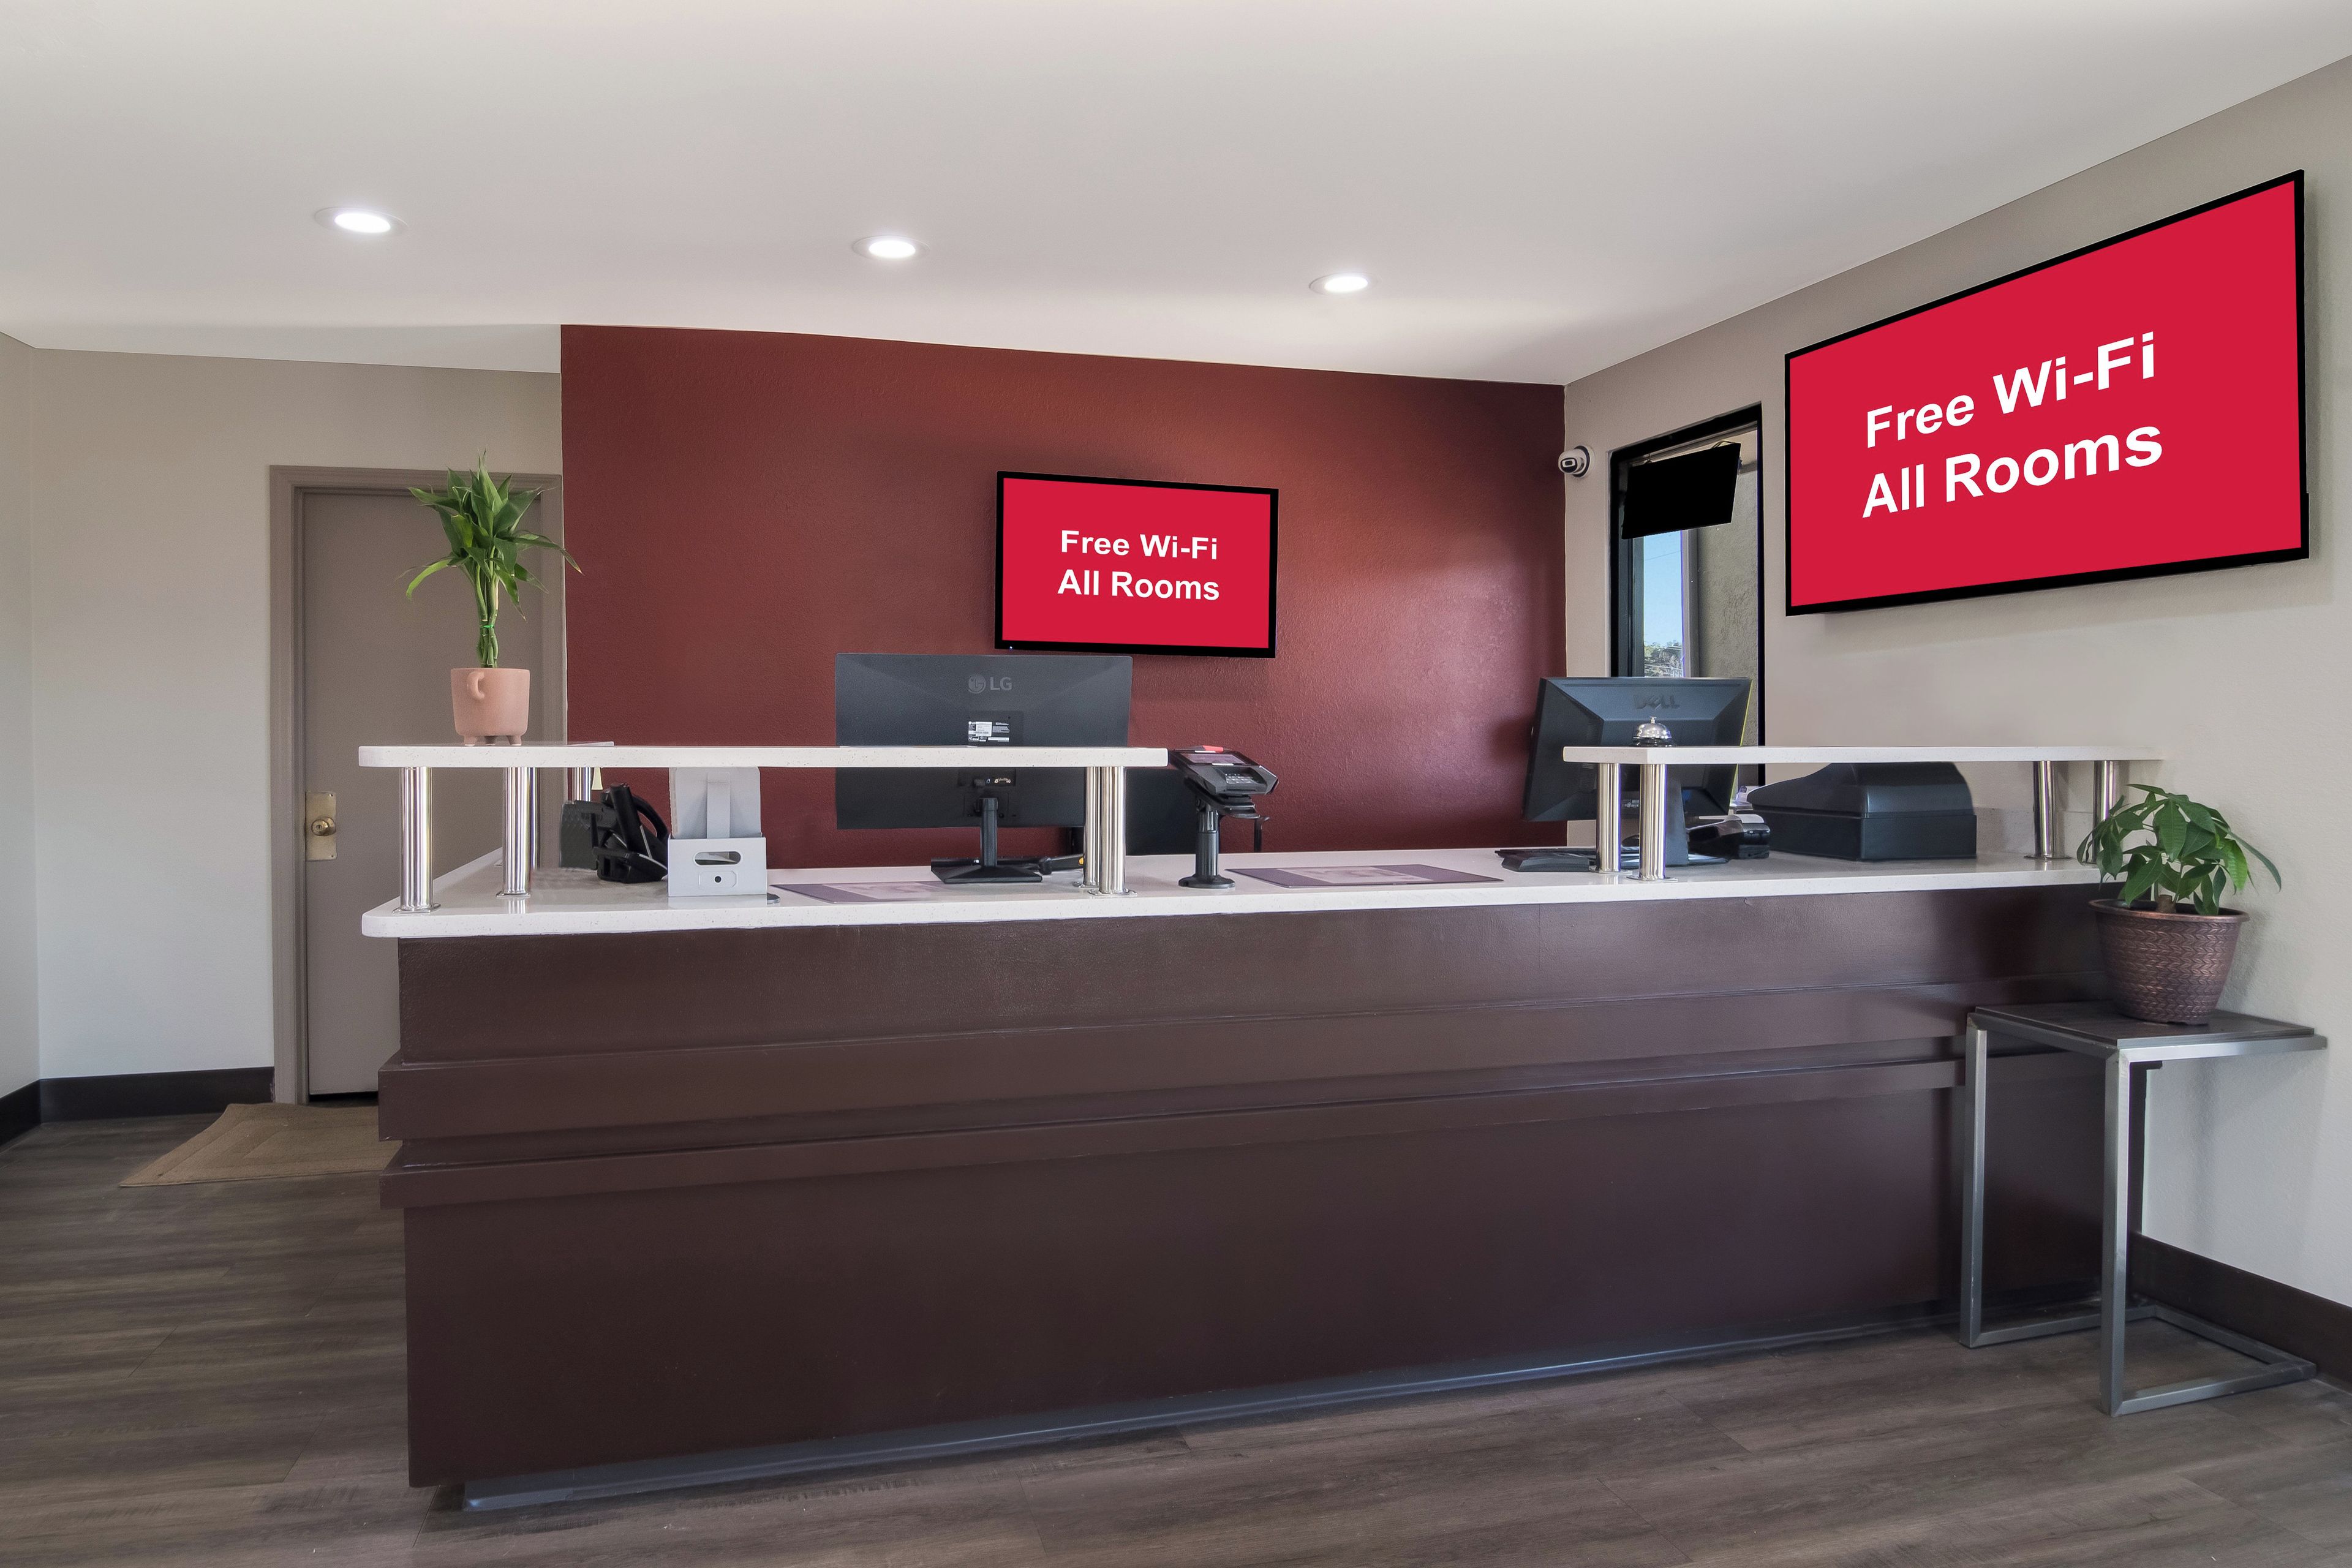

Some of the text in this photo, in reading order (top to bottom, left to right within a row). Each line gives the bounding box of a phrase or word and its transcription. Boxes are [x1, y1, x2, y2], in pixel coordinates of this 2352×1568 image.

[1866, 331, 2155, 448] Free Wi-Fi
[1862, 426, 2163, 518] All Rooms
[1061, 530, 1218, 560] Free Wi-Fi
[1057, 569, 1219, 601] All Rooms
[989, 676, 1012, 691] LG
[1633, 694, 1680, 709] DELL
